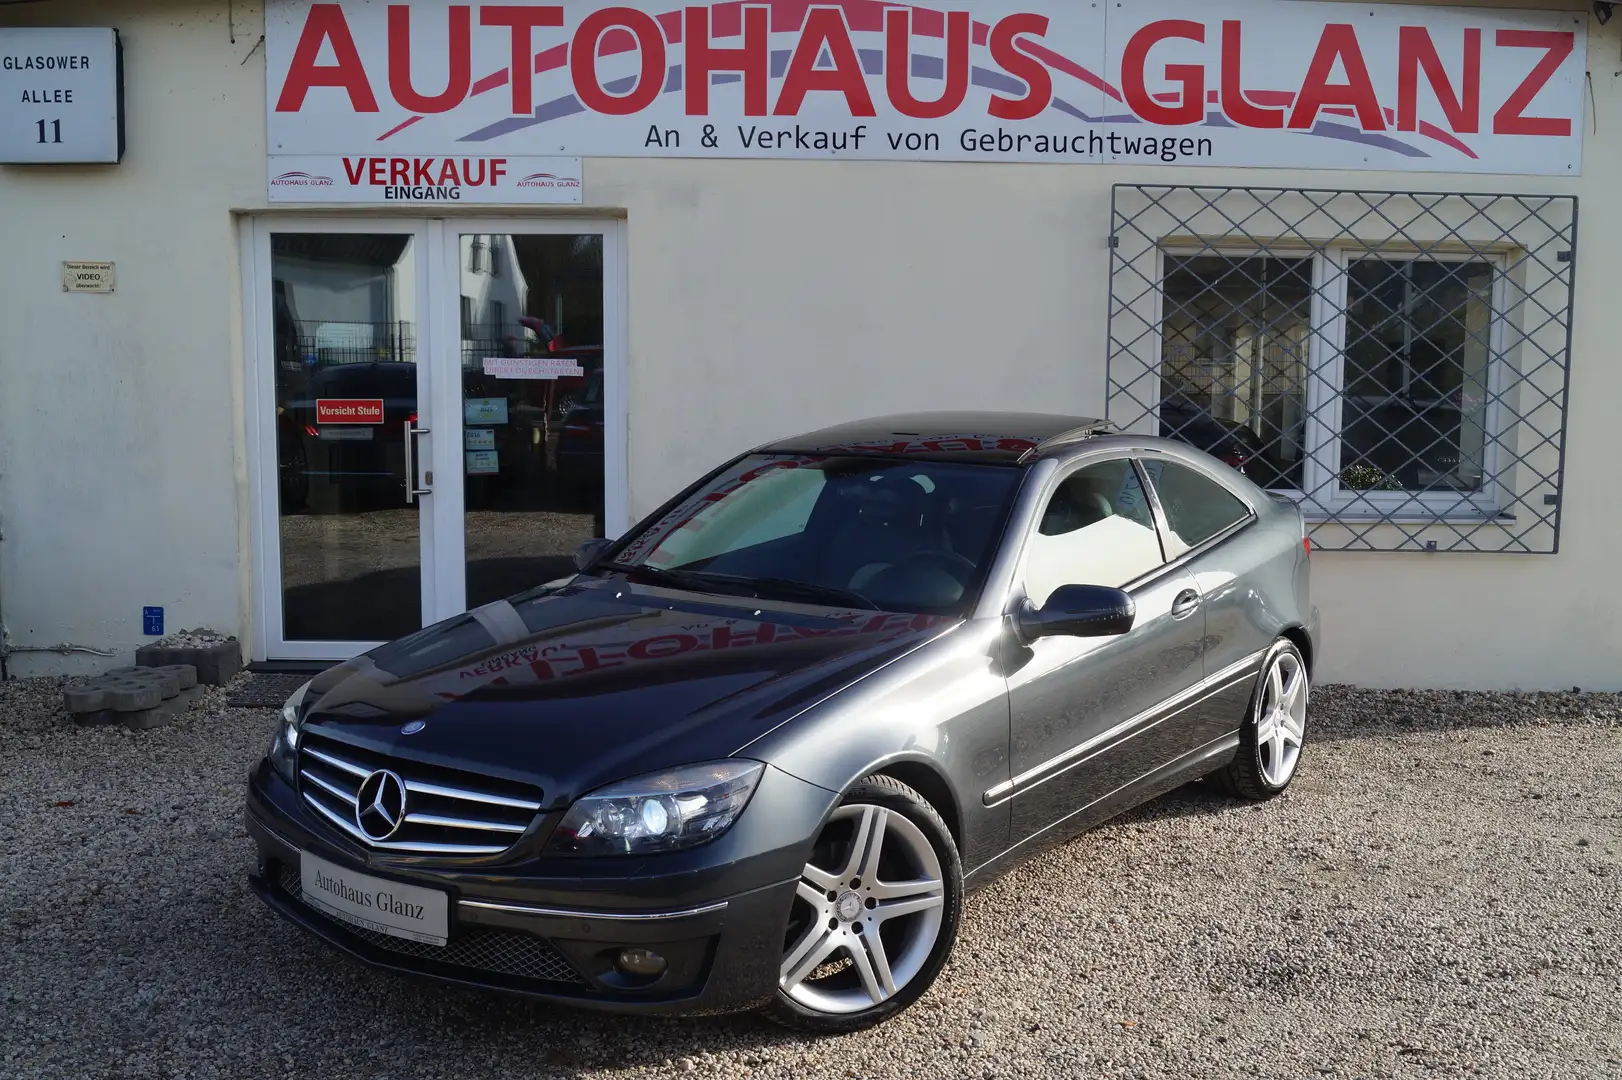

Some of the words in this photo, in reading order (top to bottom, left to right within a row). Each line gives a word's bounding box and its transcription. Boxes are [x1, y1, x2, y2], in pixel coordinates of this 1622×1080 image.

[3, 56, 90, 70] GLASOWER
[275, 3, 1053, 120] AUTOHAUS
[1120, 19, 1575, 136] GLANZ
[22, 89, 73, 103] ALLEE
[35, 118, 64, 144] 11
[644, 124, 680, 148] An
[700, 124, 719, 148] &
[737, 124, 867, 150] Verkauf
[887, 132, 939, 151] von
[960, 127, 1212, 162] Gebrauchtwagen
[342, 157, 507, 187] VERKAUF
[385, 186, 460, 200] EINGANG
[76, 273, 101, 281] VIDEO
[485, 367, 513, 375] DIREKT
[320, 405, 355, 415] Vorsicht
[357, 405, 380, 415] Stufe
[315, 870, 372, 908] Autohaus
[376, 891, 424, 921] Glanz
[336, 911, 365, 927] AUTOHAUS
[366, 921, 389, 934] GLANZ
